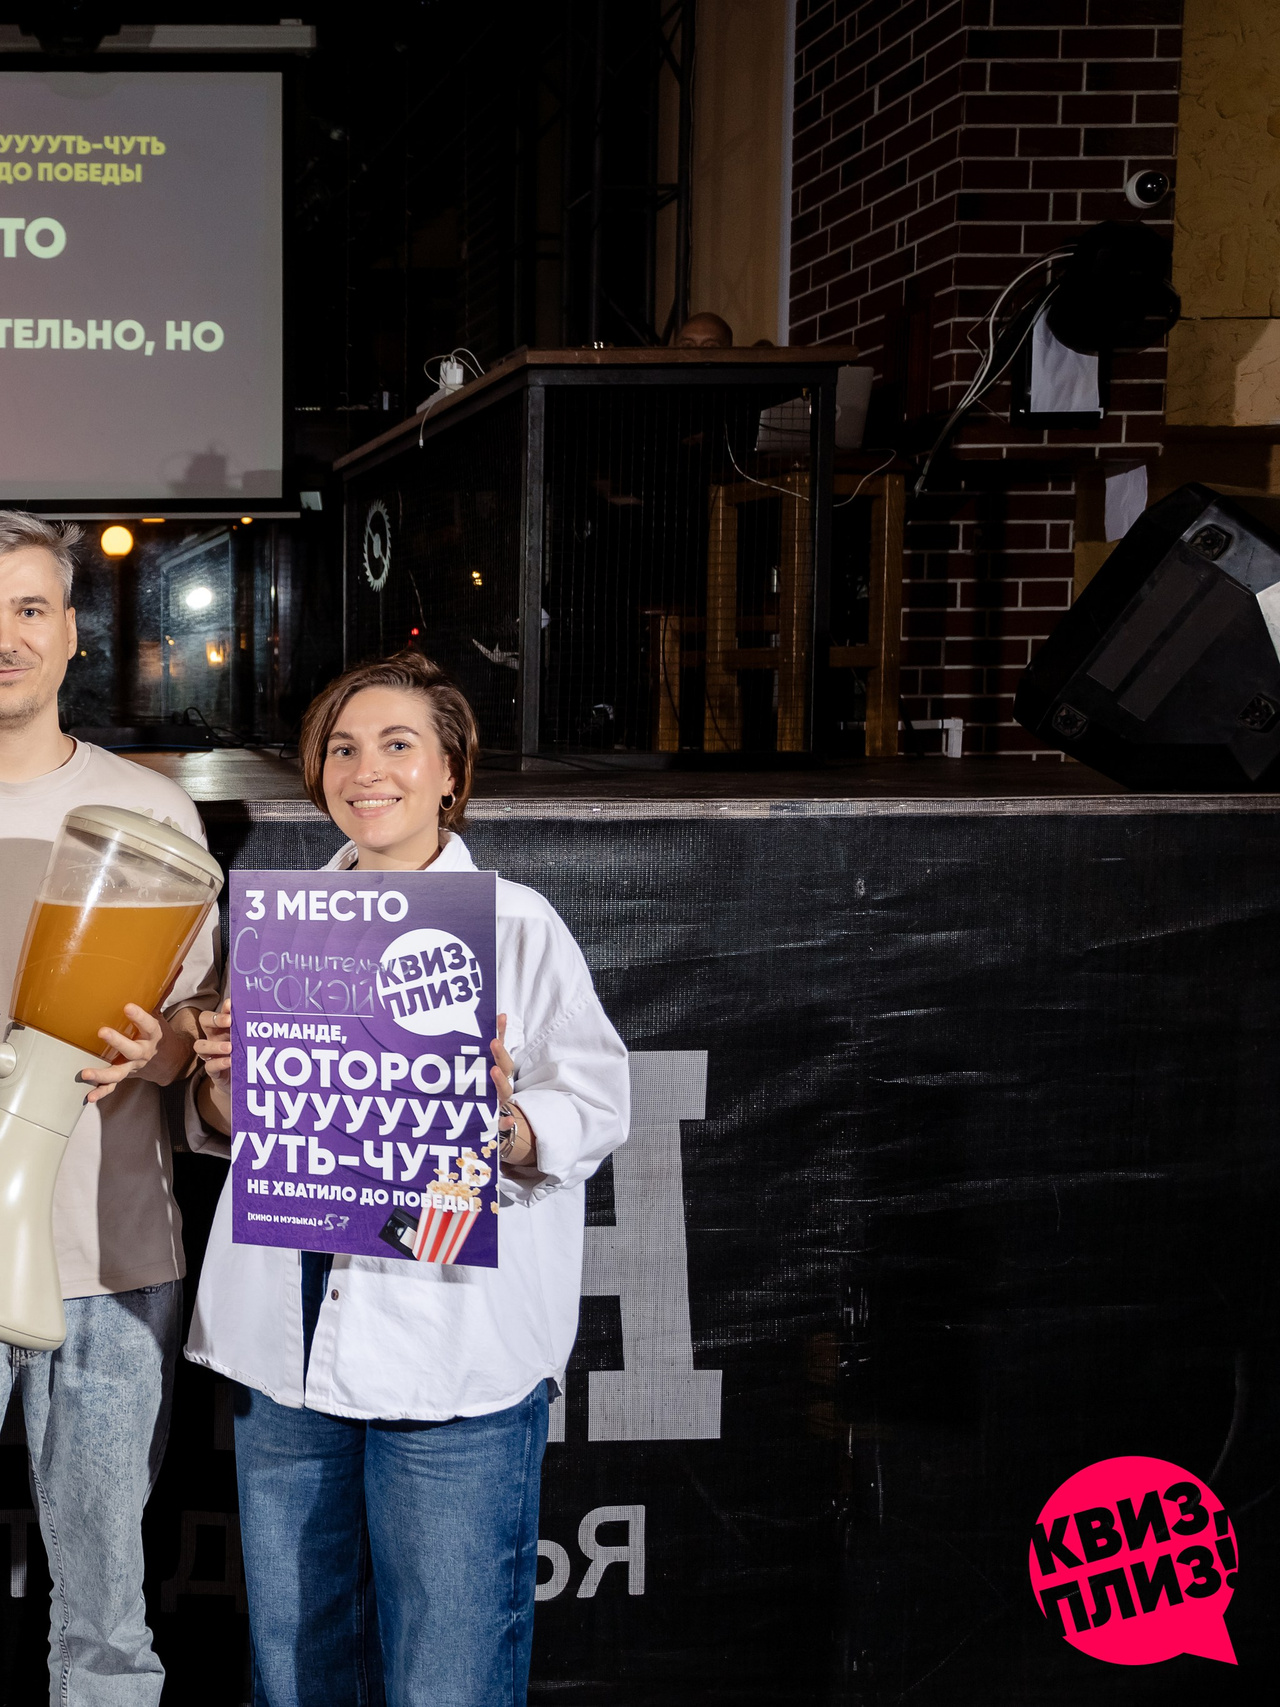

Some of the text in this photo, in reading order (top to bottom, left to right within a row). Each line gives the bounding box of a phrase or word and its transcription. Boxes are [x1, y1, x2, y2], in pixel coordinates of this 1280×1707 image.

[37, 163, 143, 186] ПОБЕДЫ
[166, 320, 224, 353] НО
[245, 890, 409, 923] 3 МЕСТО
[379, 942, 477, 989] КВИЗ,
[382, 972, 483, 1019] ПЛИЗ!
[246, 1021, 347, 1044] КОМАНДЕ,
[246, 1045, 487, 1096] КОТОРОЙ
[247, 1178, 474, 1212] НЕ ХВАТИЛО ДО ПОБЕДЫ
[247, 1212, 272, 1221] [КИНО
[273, 1215, 279, 1223] И
[280, 1215, 316, 1227] МУЗЫКА]
